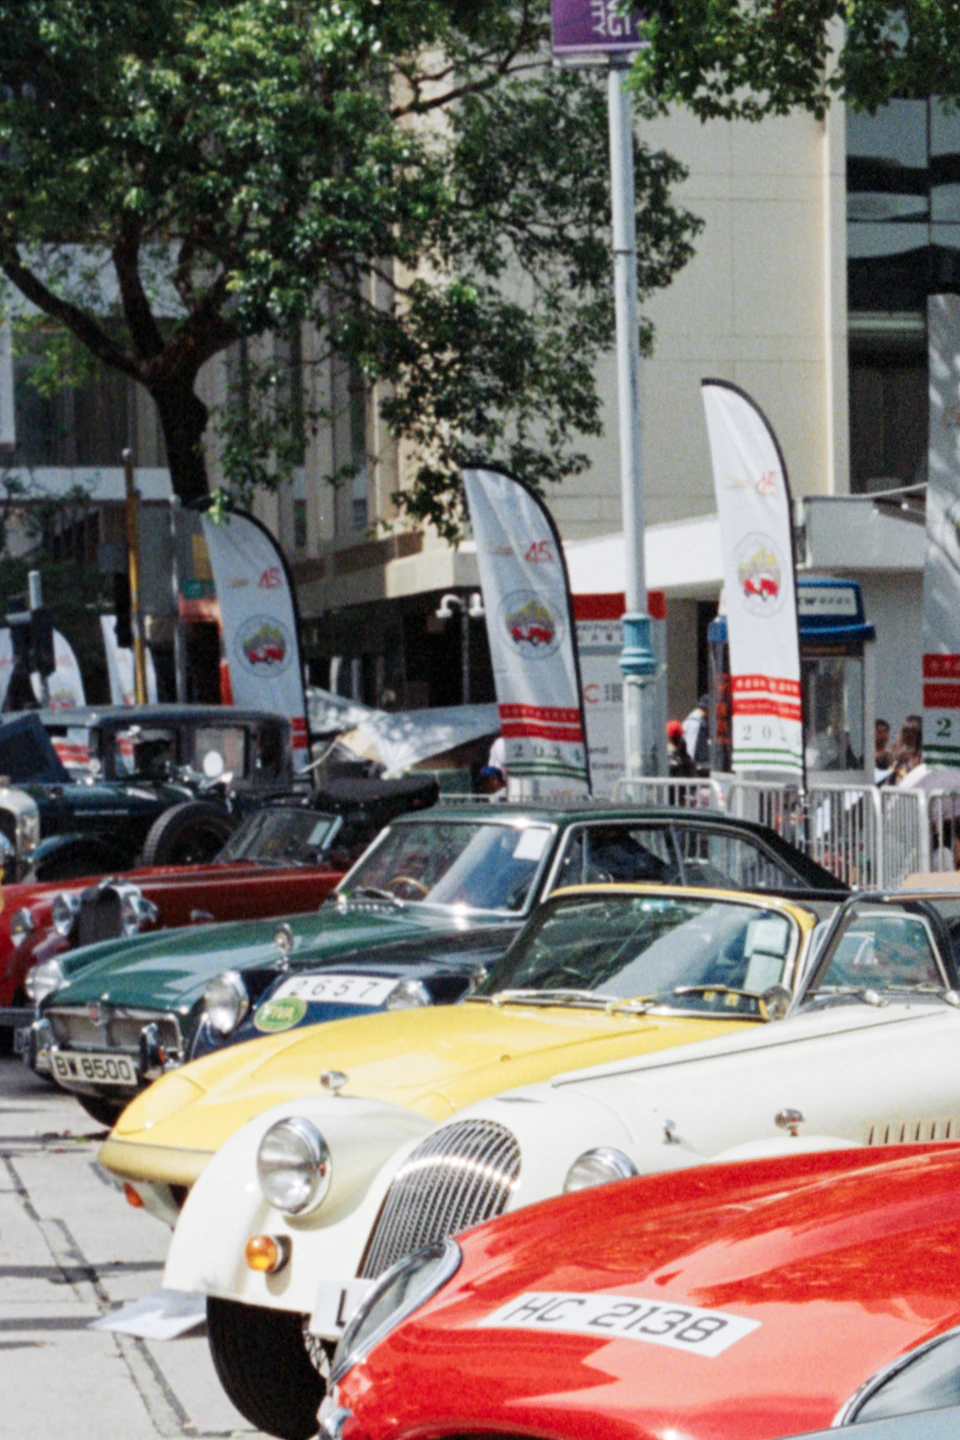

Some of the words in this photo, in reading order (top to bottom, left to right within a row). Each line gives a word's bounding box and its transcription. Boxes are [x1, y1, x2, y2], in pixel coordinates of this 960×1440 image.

[288, 979, 381, 999] 2657
[54, 1055, 78, 1077] BW
[81, 1057, 132, 1080] 8500
[501, 1296, 587, 1322] HC
[587, 1302, 729, 1344] 2138
